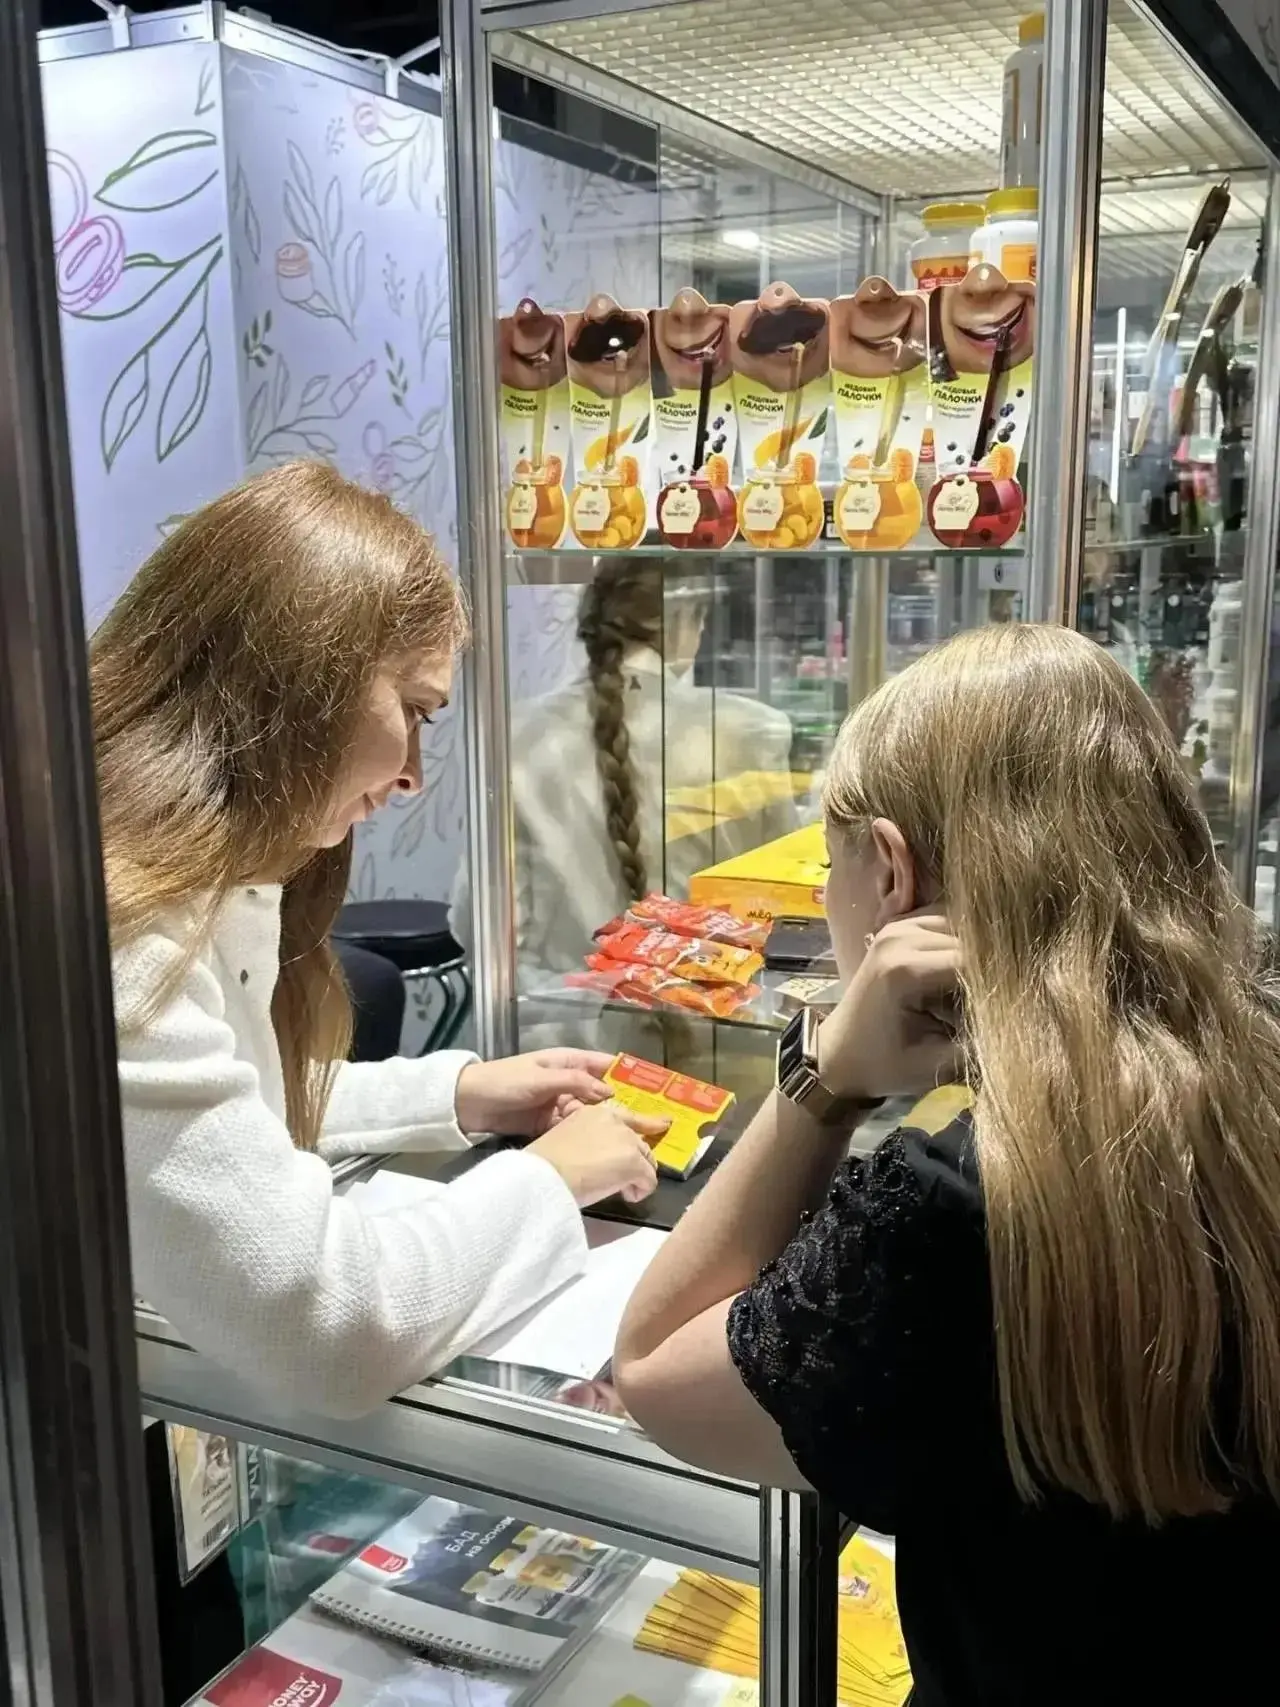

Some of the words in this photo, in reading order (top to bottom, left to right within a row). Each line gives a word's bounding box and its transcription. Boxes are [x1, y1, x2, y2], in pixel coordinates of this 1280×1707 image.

[837, 388, 882, 401] ПАЛОЧКИ
[934, 390, 982, 403] ПАЛОЧКИ
[571, 404, 611, 417] ПАЛОЧКИ
[656, 404, 697, 417] ПАЛОЧКИ
[739, 399, 784, 412] ПАЛОЧКИ
[445, 1531, 480, 1553] БАД
